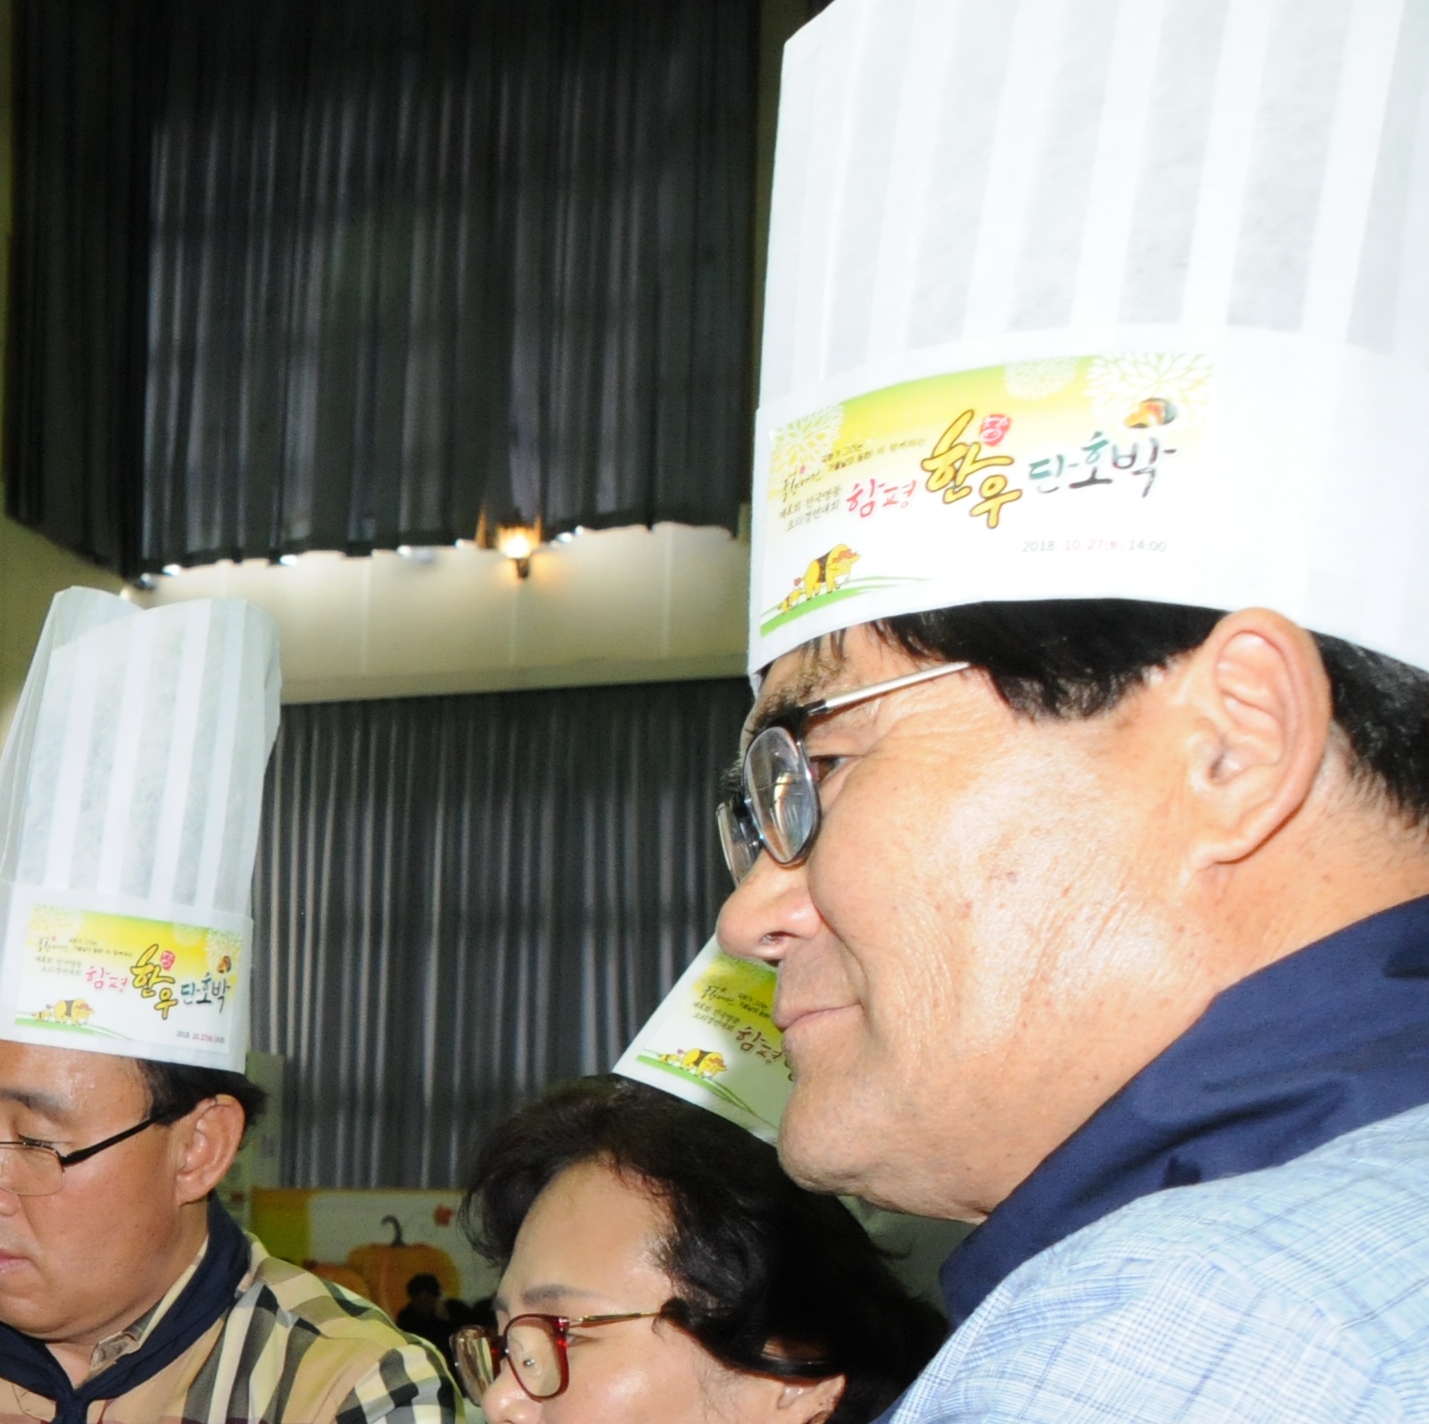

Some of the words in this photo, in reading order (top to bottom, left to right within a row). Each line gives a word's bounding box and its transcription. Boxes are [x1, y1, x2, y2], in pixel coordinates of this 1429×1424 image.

[845, 477, 918, 519] 함평
[921, 409, 1023, 531] 한우
[1028, 430, 1177, 498] 단호박
[85, 965, 129, 993] 함평
[130, 943, 179, 1020] 한우
[180, 972, 231, 1014] 단호박
